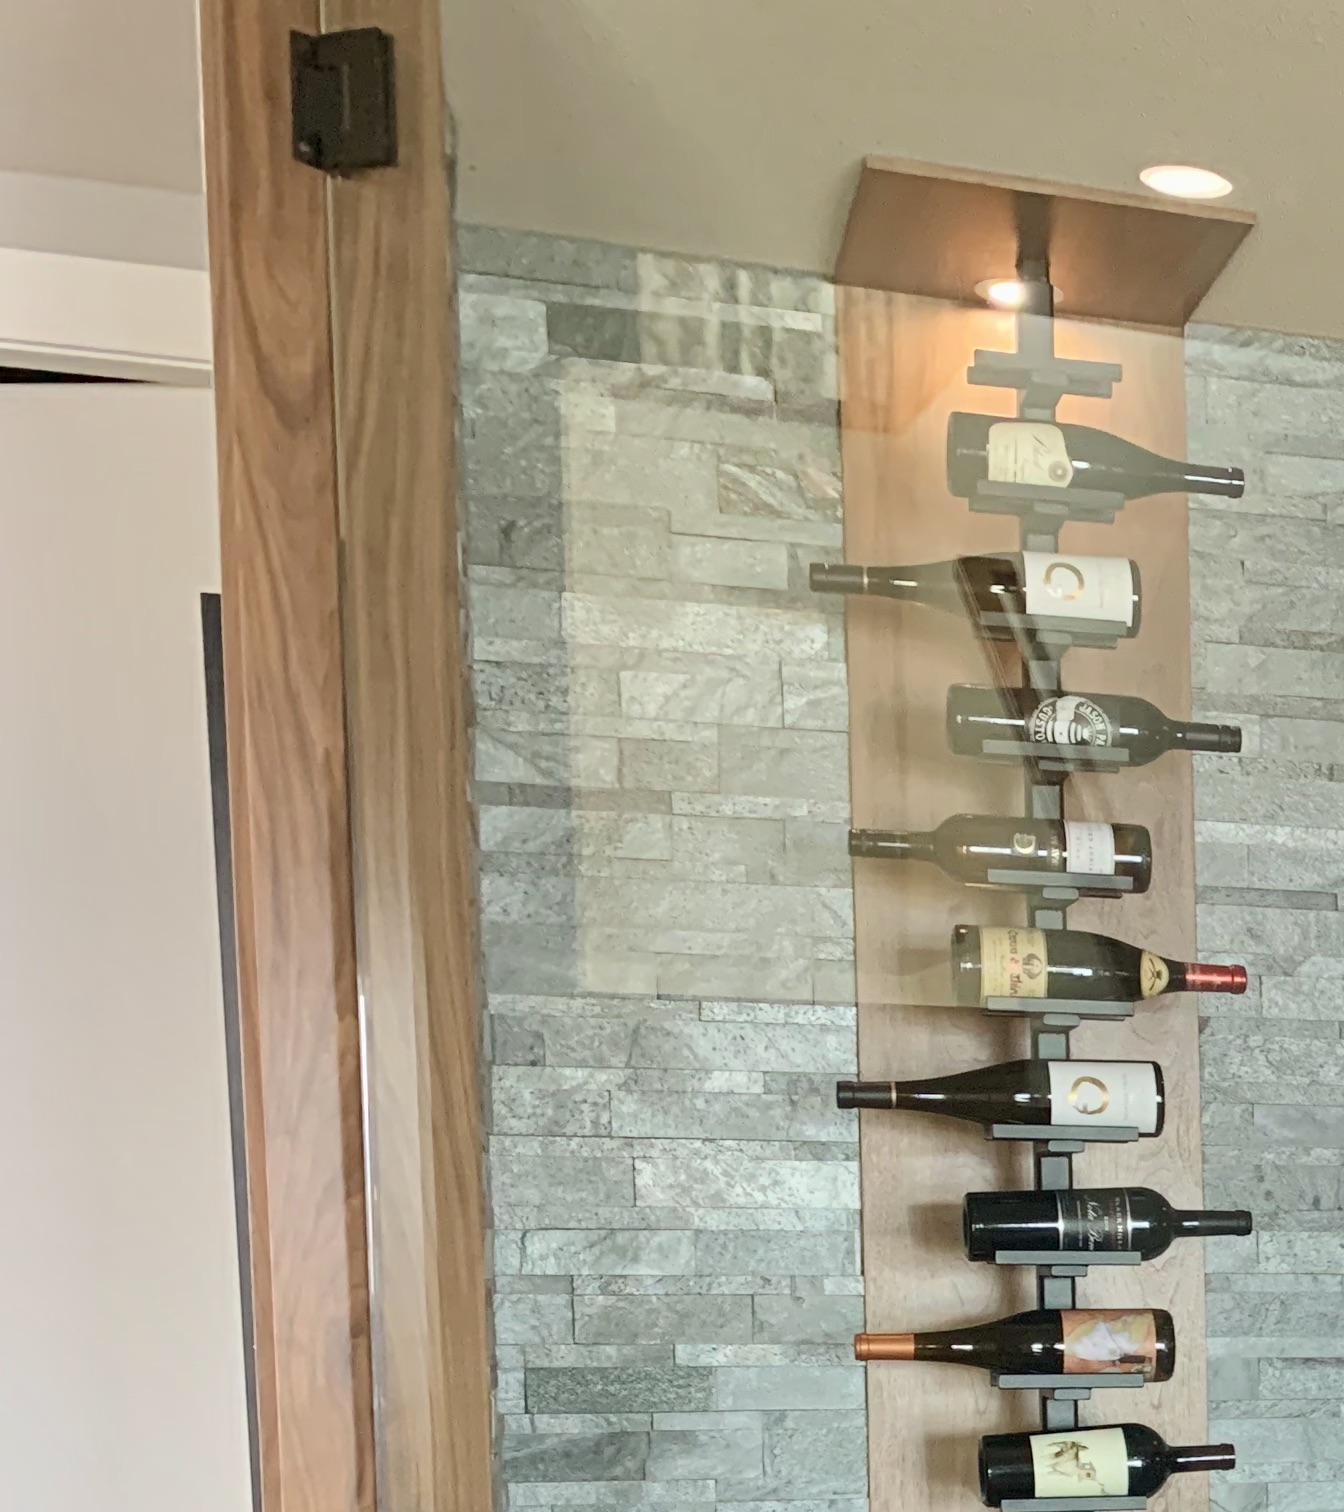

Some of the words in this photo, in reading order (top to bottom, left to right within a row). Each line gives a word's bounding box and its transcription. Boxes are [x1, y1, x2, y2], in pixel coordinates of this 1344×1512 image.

[1034, 706, 1053, 743] CUSTO
[1079, 704, 1106, 731] JASON
[1084, 1196, 1101, 1221] Nota
[1087, 1227, 1103, 1250] Ben
